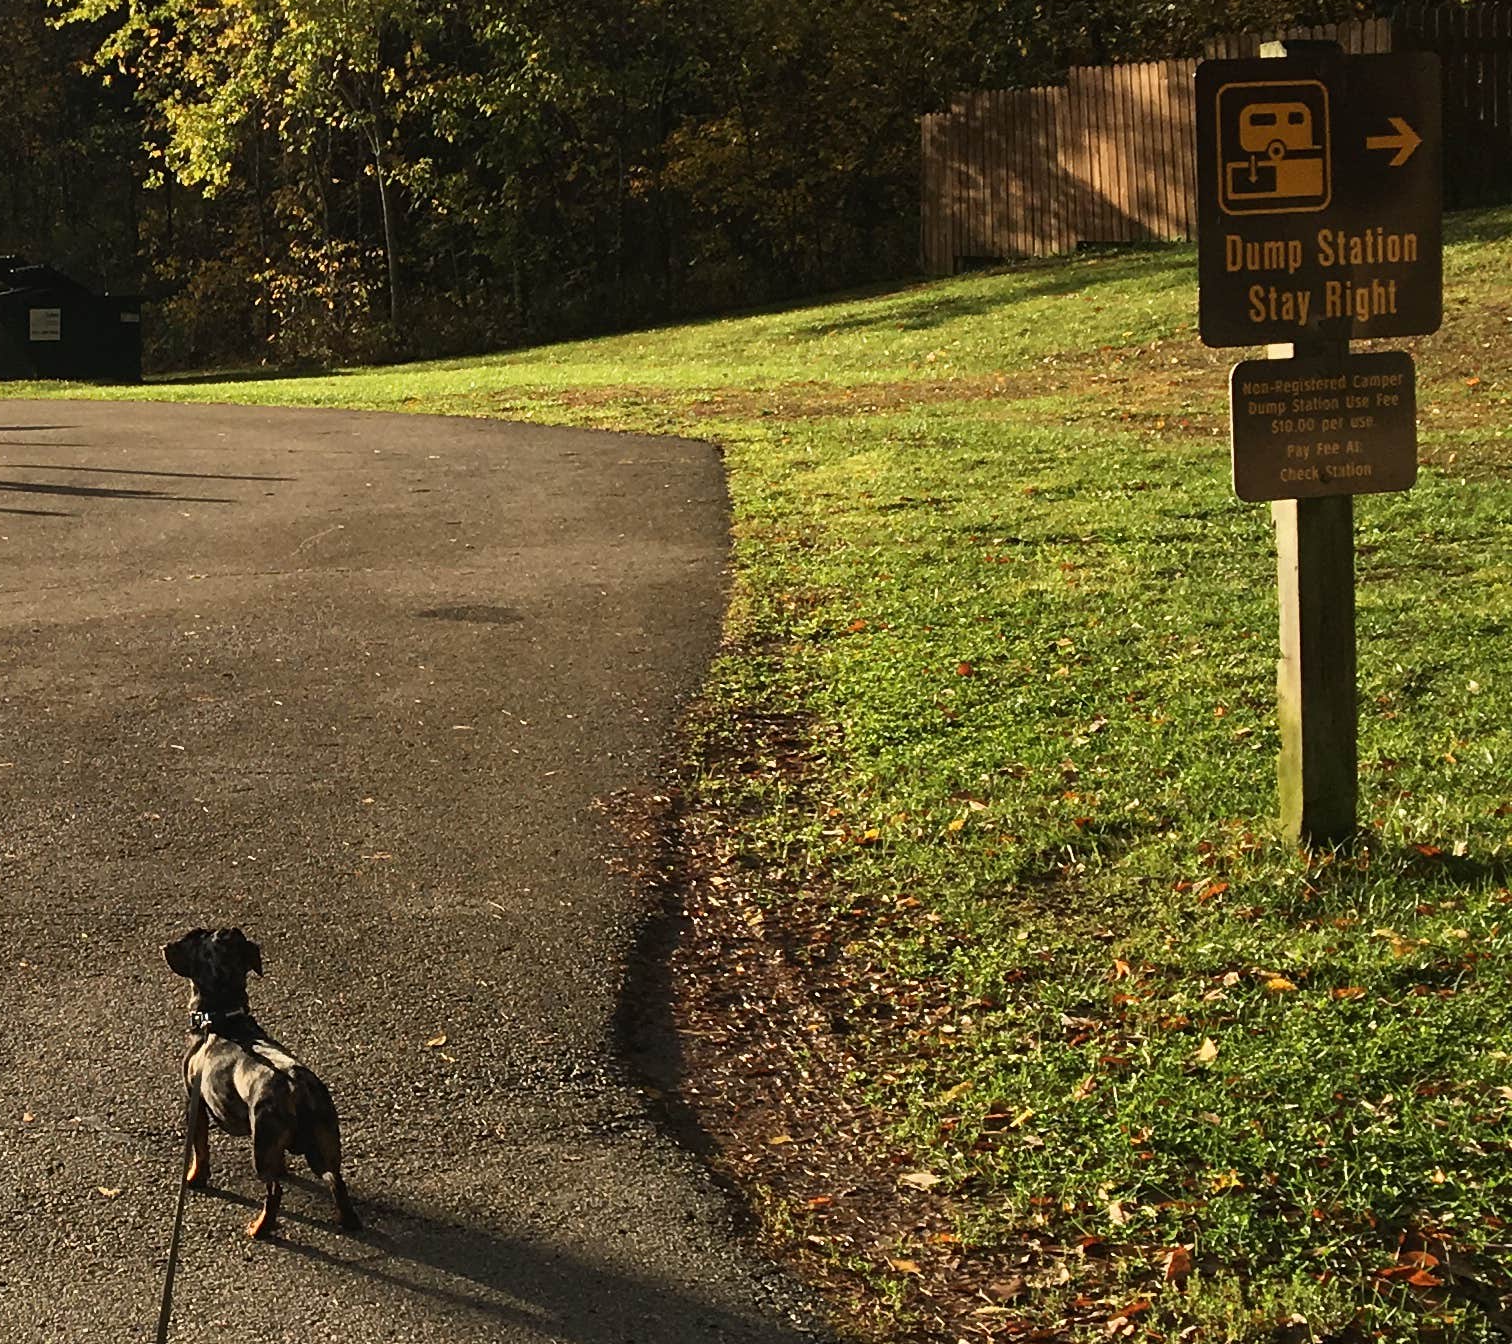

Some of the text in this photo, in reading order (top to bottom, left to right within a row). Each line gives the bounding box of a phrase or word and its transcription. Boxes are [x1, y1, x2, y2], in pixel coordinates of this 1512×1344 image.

[1226, 227, 1417, 274] Dump Station
[1248, 279, 1397, 325] Stay Right
[1242, 374, 1403, 395] Non-Registered Camper
[1248, 393, 1399, 416] Dump Station Use Fee
[1271, 418, 1315, 434] $10.00
[1322, 418, 1344, 432] per
[1288, 444, 1310, 460] Pay
[1316, 442, 1340, 456] Fee
[1280, 462, 1372, 482] Check Station
